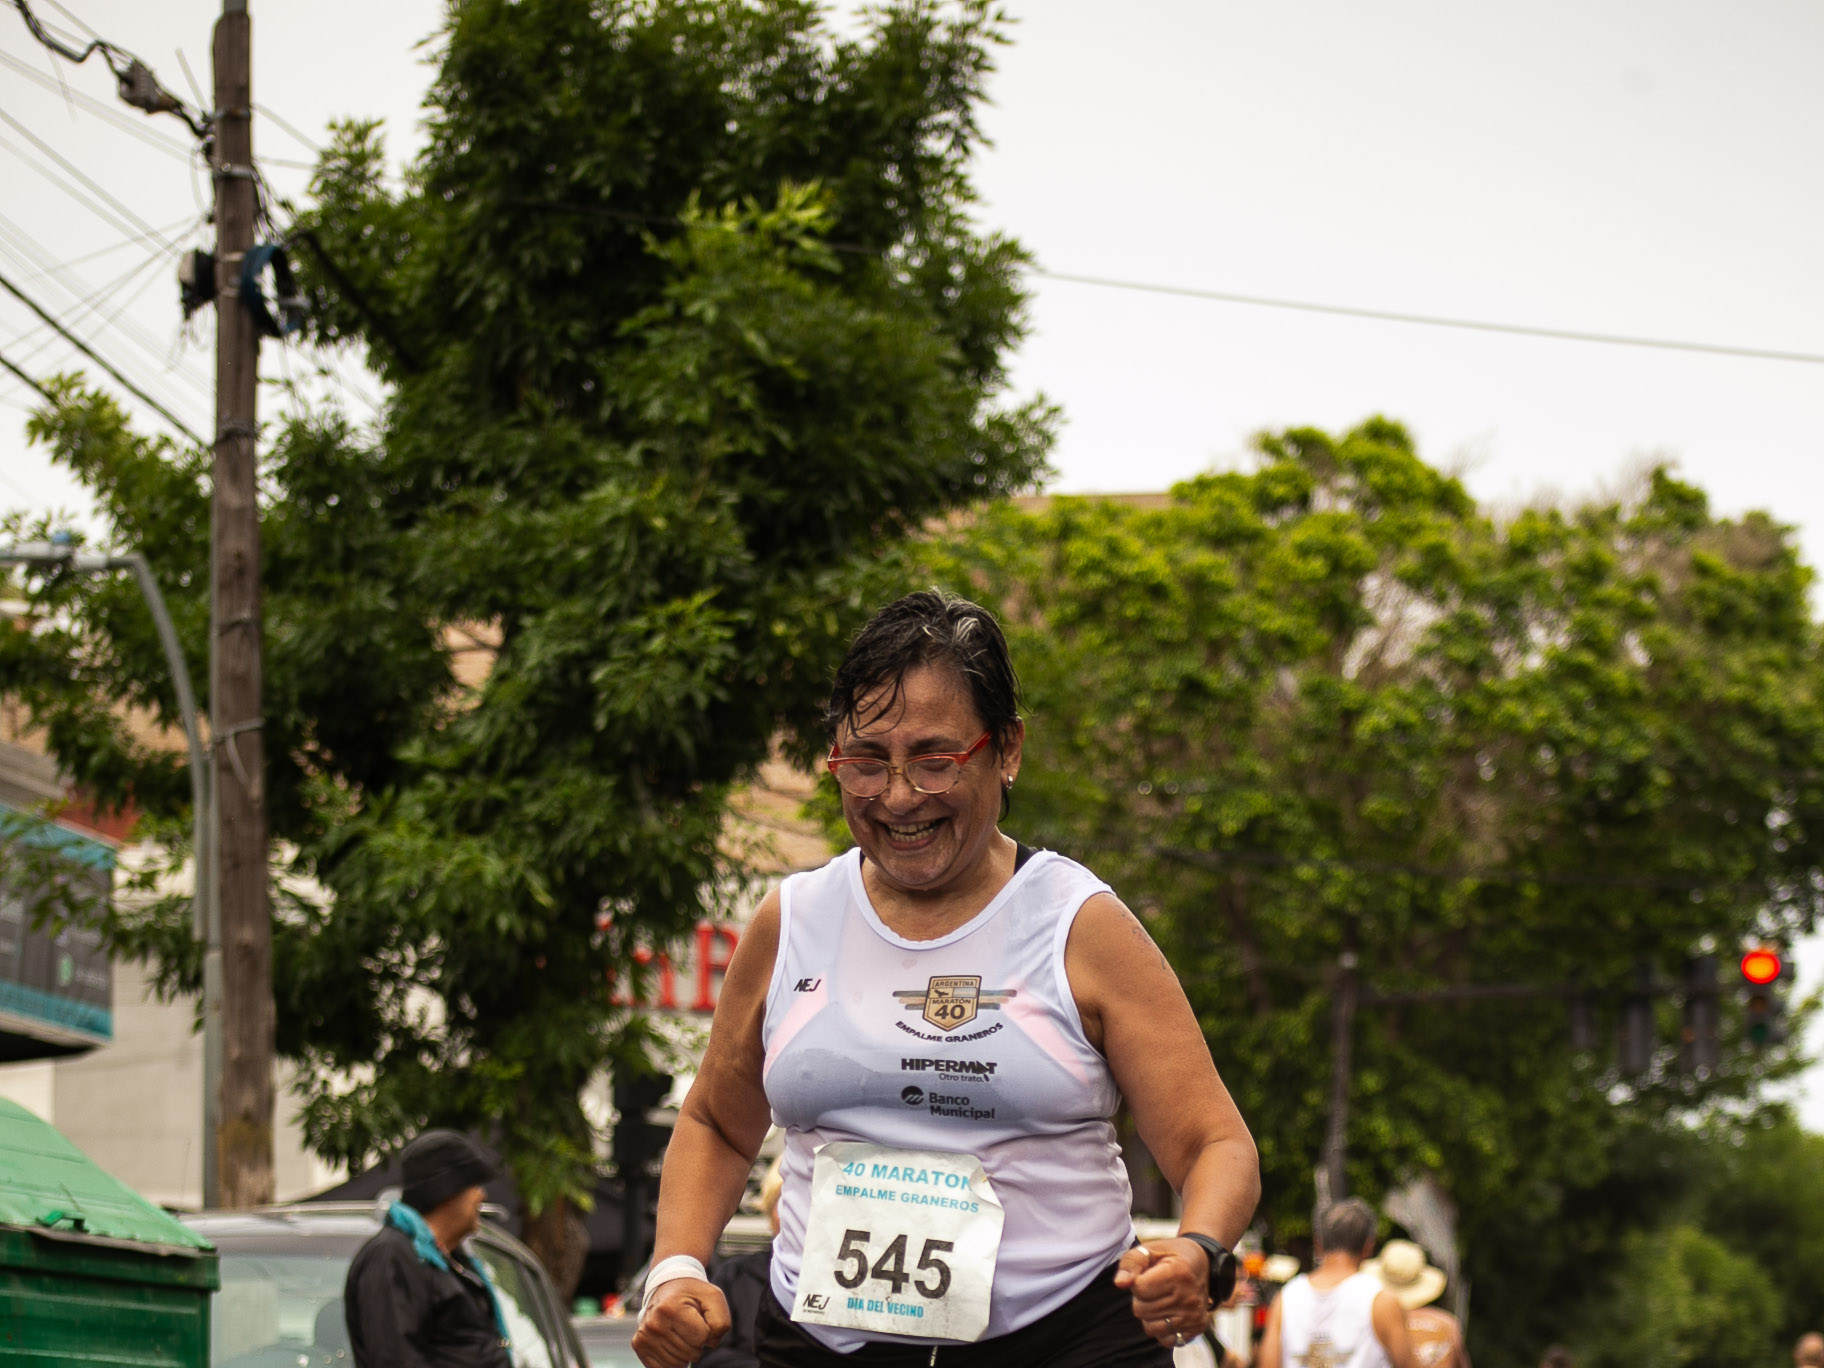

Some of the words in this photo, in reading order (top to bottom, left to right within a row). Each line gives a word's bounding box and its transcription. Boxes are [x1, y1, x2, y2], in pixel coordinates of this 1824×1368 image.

[934, 1004, 965, 1019] 40
[895, 1020, 943, 1042] EMPALME
[945, 1022, 1004, 1042] GRANEROS
[939, 1073, 959, 1081] Otro
[929, 1092, 970, 1106] Banco
[930, 1105, 995, 1120] Municipal
[842, 1162, 866, 1177] 40
[835, 1185, 896, 1201] EMPALME
[901, 1192, 979, 1213] GRANEROS
[834, 1229, 954, 1299] 545
[867, 1299, 884, 1313] DEL
[887, 1302, 924, 1318] VECINO
